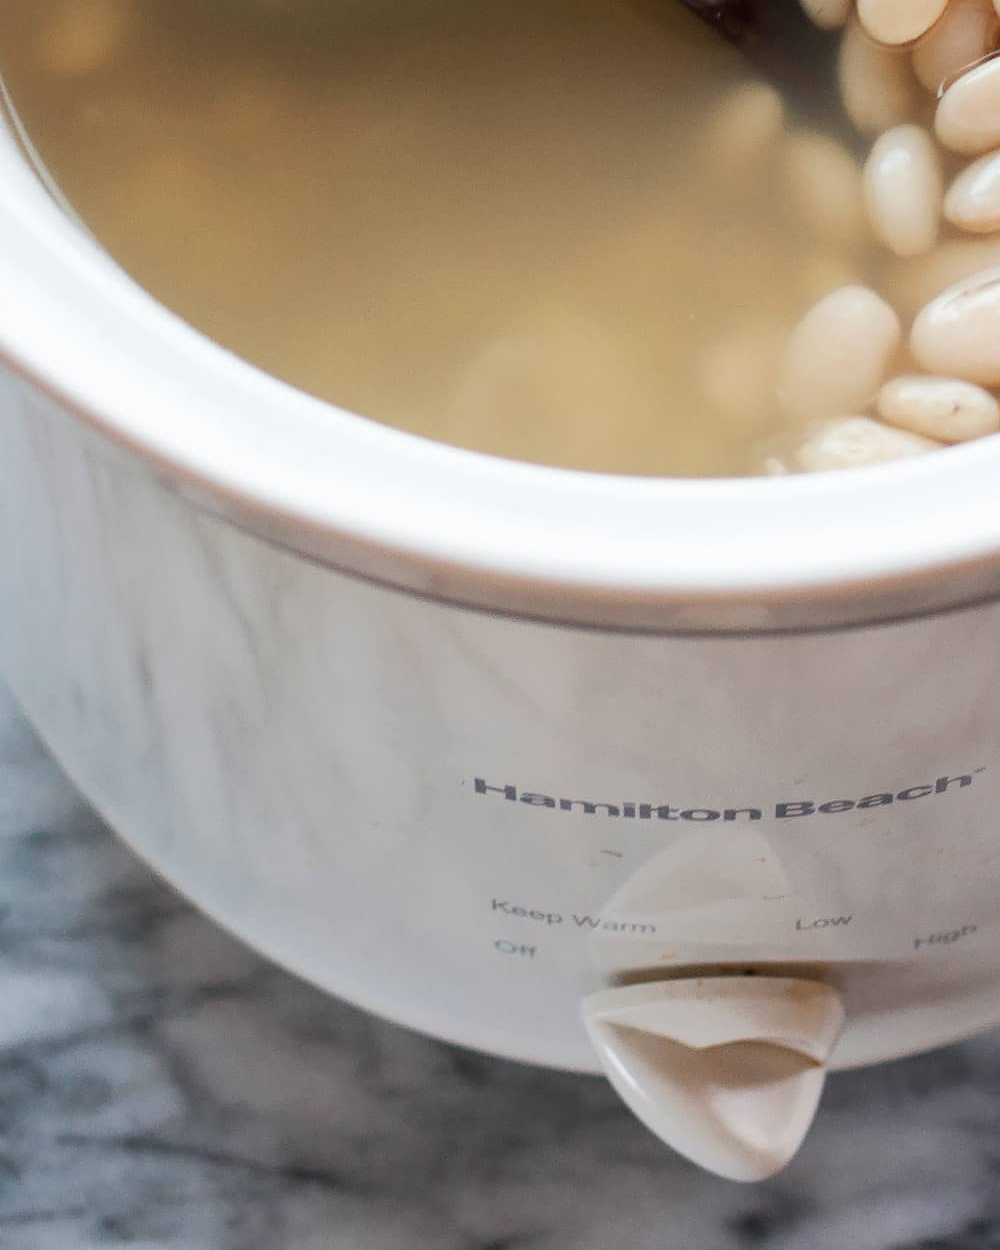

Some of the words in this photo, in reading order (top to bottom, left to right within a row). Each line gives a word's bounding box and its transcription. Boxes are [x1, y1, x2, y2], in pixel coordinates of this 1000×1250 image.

[473, 777, 762, 822] Hamilton
[774, 773, 973, 819] Beach
[491, 899, 562, 926] Keep
[572, 912, 657, 934] Warm
[795, 913, 853, 931] Low
[913, 924, 977, 948] High
[493, 939, 537, 958] Off
